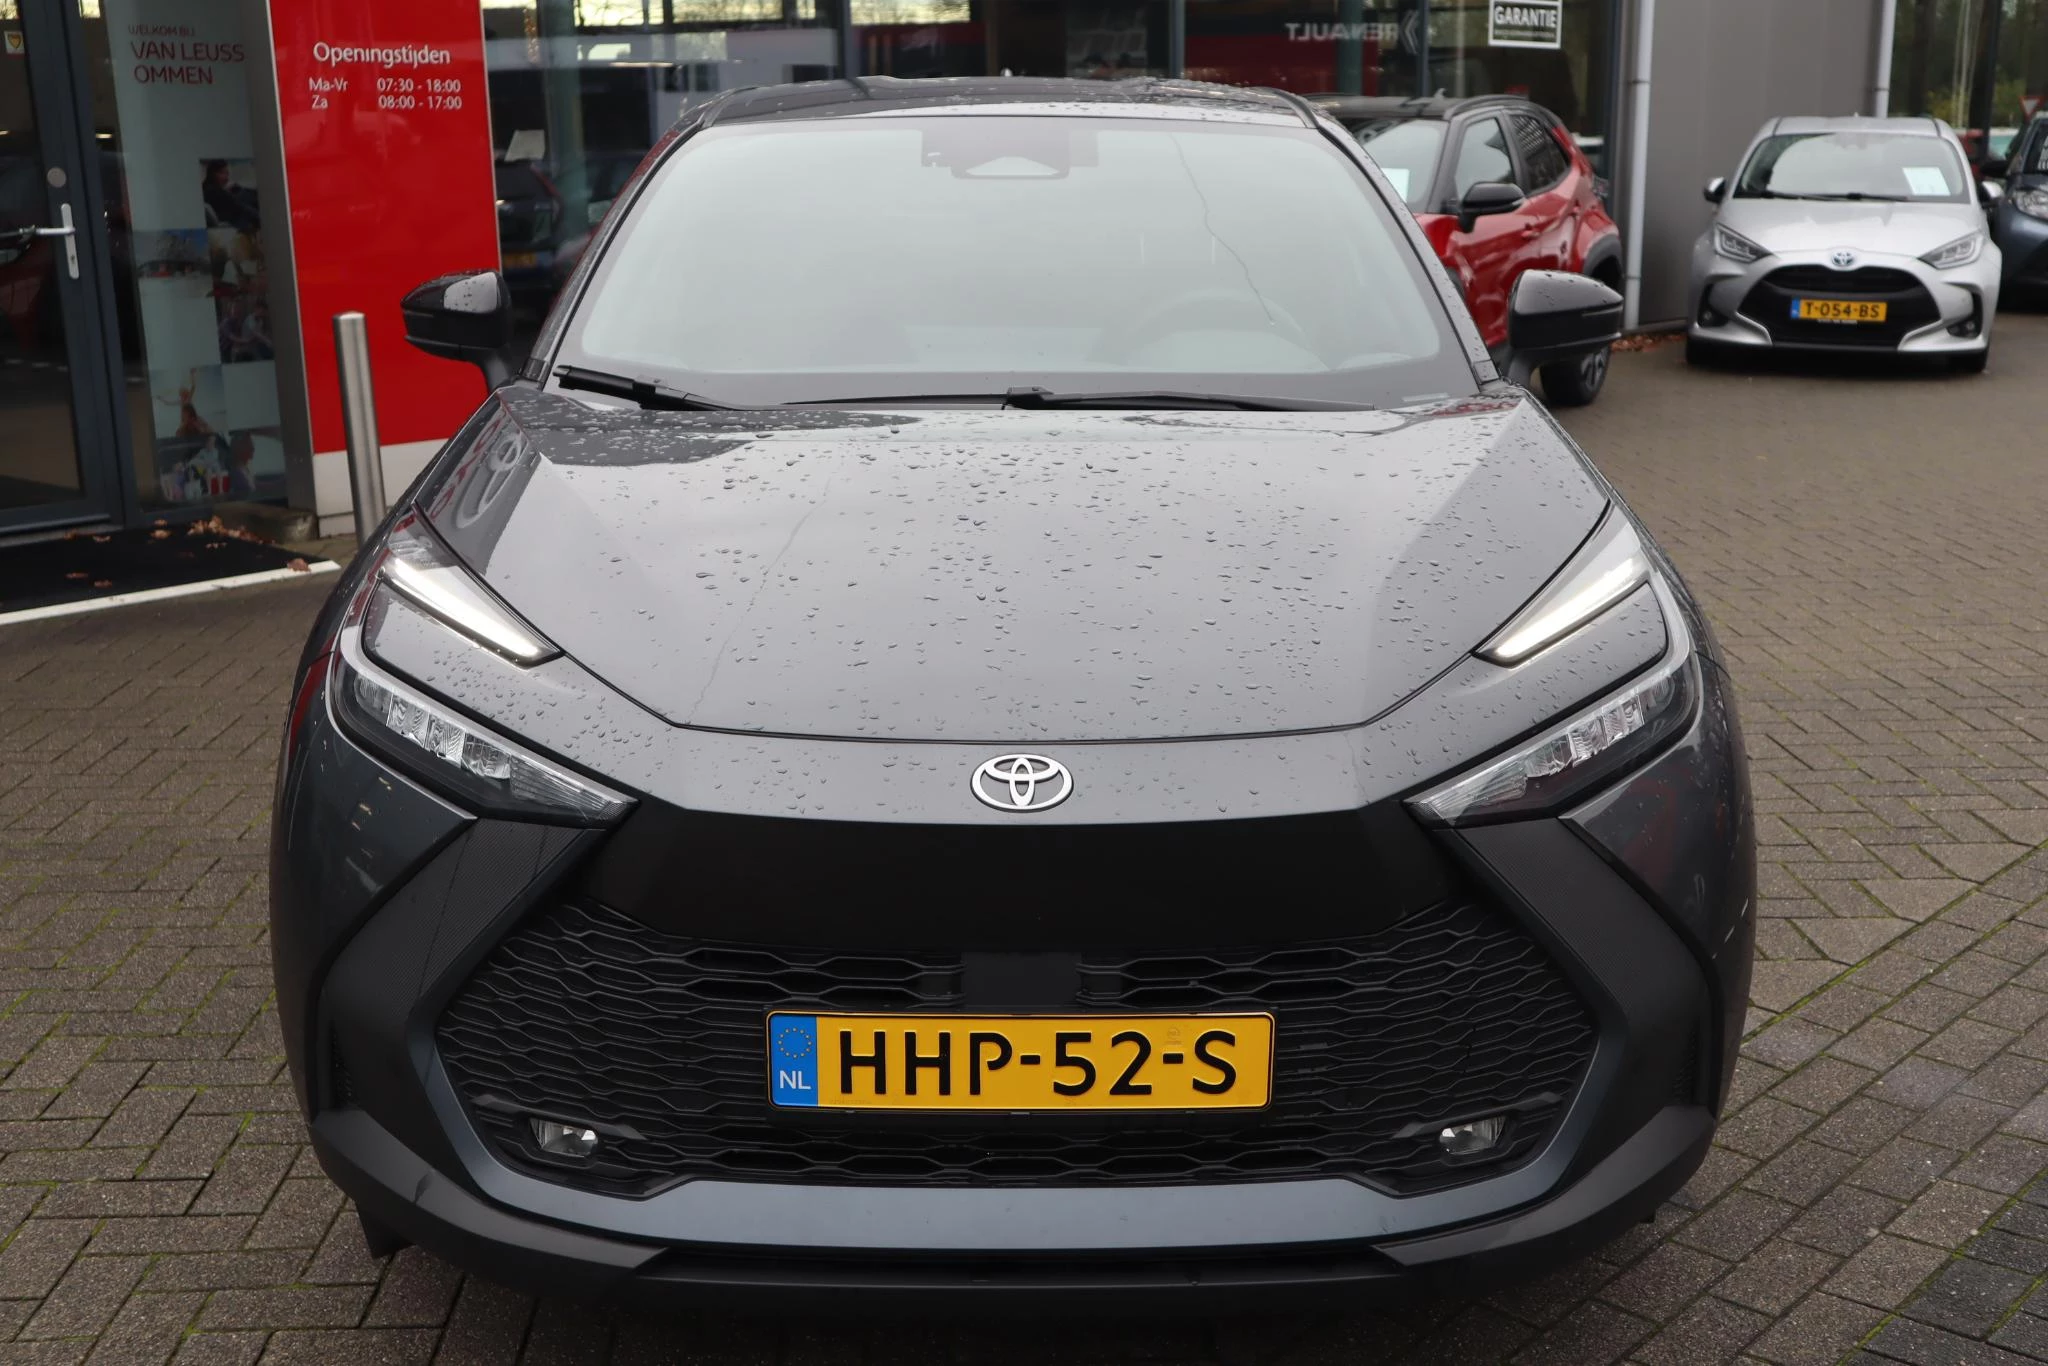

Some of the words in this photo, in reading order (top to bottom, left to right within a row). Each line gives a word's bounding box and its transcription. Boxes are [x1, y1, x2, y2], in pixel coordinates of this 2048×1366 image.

[1495, 5, 1557, 28] GARANTIE
[131, 41, 175, 60] VAN
[181, 42, 245, 62] LEUSS
[313, 41, 451, 69] Openingstijden
[134, 64, 214, 85] OMMEN
[308, 77, 348, 92] Ma-Vr
[376, 77, 414, 92] 07:30
[426, 78, 461, 93] 18:00
[311, 95, 328, 109] Za
[378, 95, 415, 110] 08:00
[428, 96, 463, 110] 17:00
[1805, 301, 1880, 318] T-054-BS
[839, 1030, 1237, 1097] HHP-52-S
[779, 1070, 811, 1090] NL
